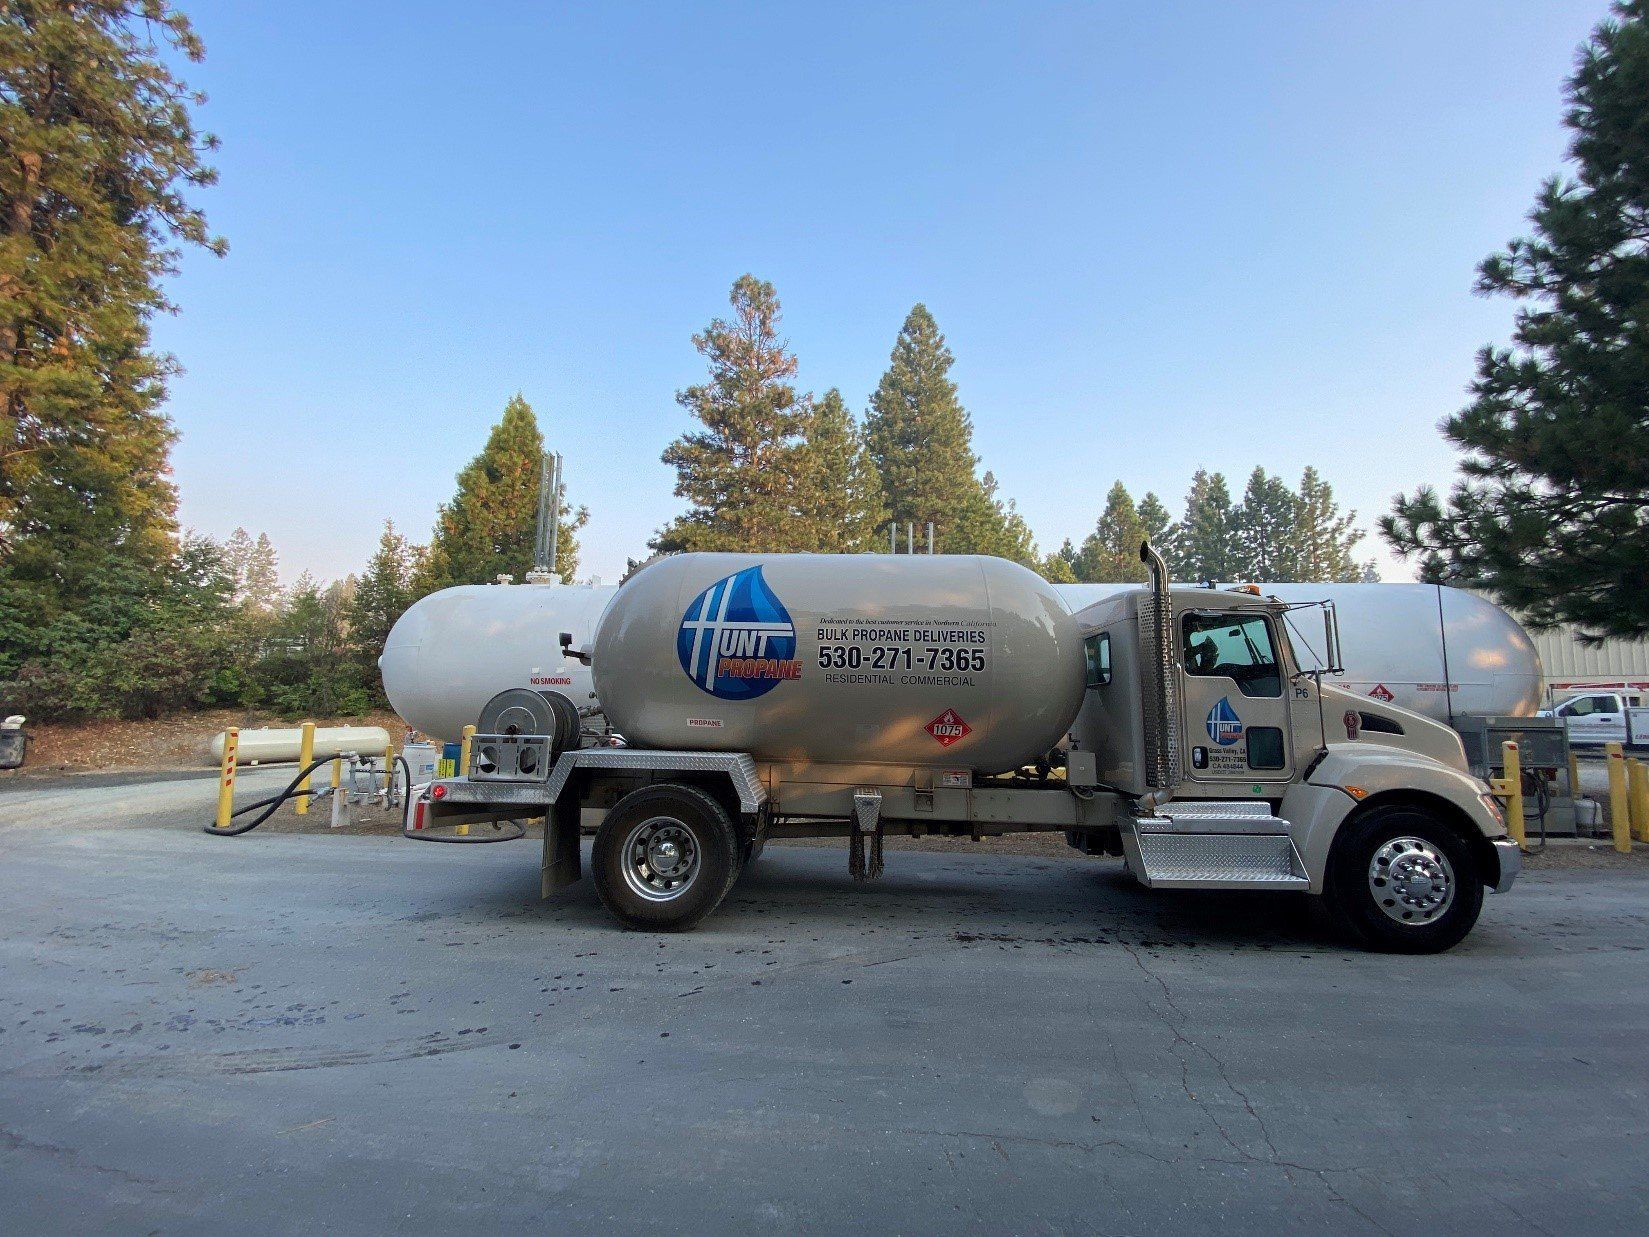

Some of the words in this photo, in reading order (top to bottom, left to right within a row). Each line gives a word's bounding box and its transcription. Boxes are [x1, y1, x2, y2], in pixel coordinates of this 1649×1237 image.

[820, 617, 848, 625] Dedicated
[683, 575, 794, 691] HUNT
[817, 628, 848, 641] BULK
[852, 629, 909, 642] PROPANE
[913, 629, 986, 644] DELIVERIES
[817, 645, 986, 672] 530-271-7365
[718, 658, 803, 680] PROPANE
[530, 677, 540, 685] NO
[540, 677, 571, 685] SMOKING
[825, 673, 895, 685] RESIDENTIAL
[900, 675, 976, 687] COMMERCIAL
[1295, 688, 1309, 699] P6
[689, 719, 722, 727] PROPANE
[934, 724, 962, 737] 1075
